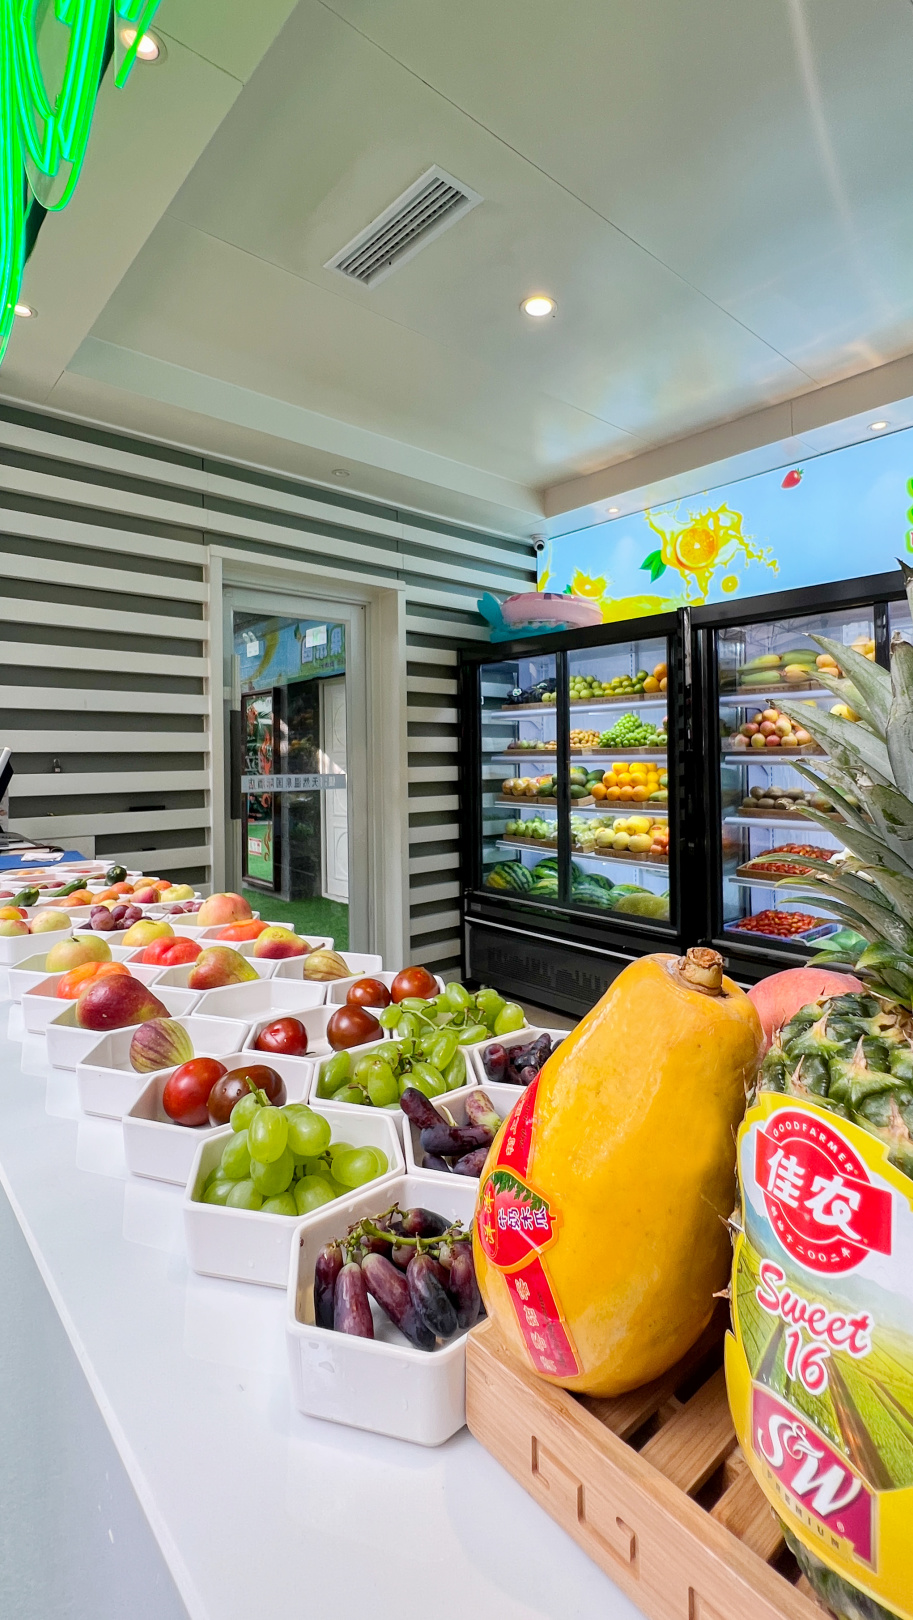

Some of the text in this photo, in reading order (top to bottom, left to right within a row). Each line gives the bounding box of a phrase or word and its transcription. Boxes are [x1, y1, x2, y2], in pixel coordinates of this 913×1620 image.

[773, 1121, 853, 1172] GOODFARMER
[498, 1206, 549, 1231] 牛奶木瓜
[767, 1147, 862, 1240] 佳农
[756, 1261, 871, 1355] Sweet
[786, 1329, 828, 1392] 16
[757, 1414, 862, 1517] S&W
